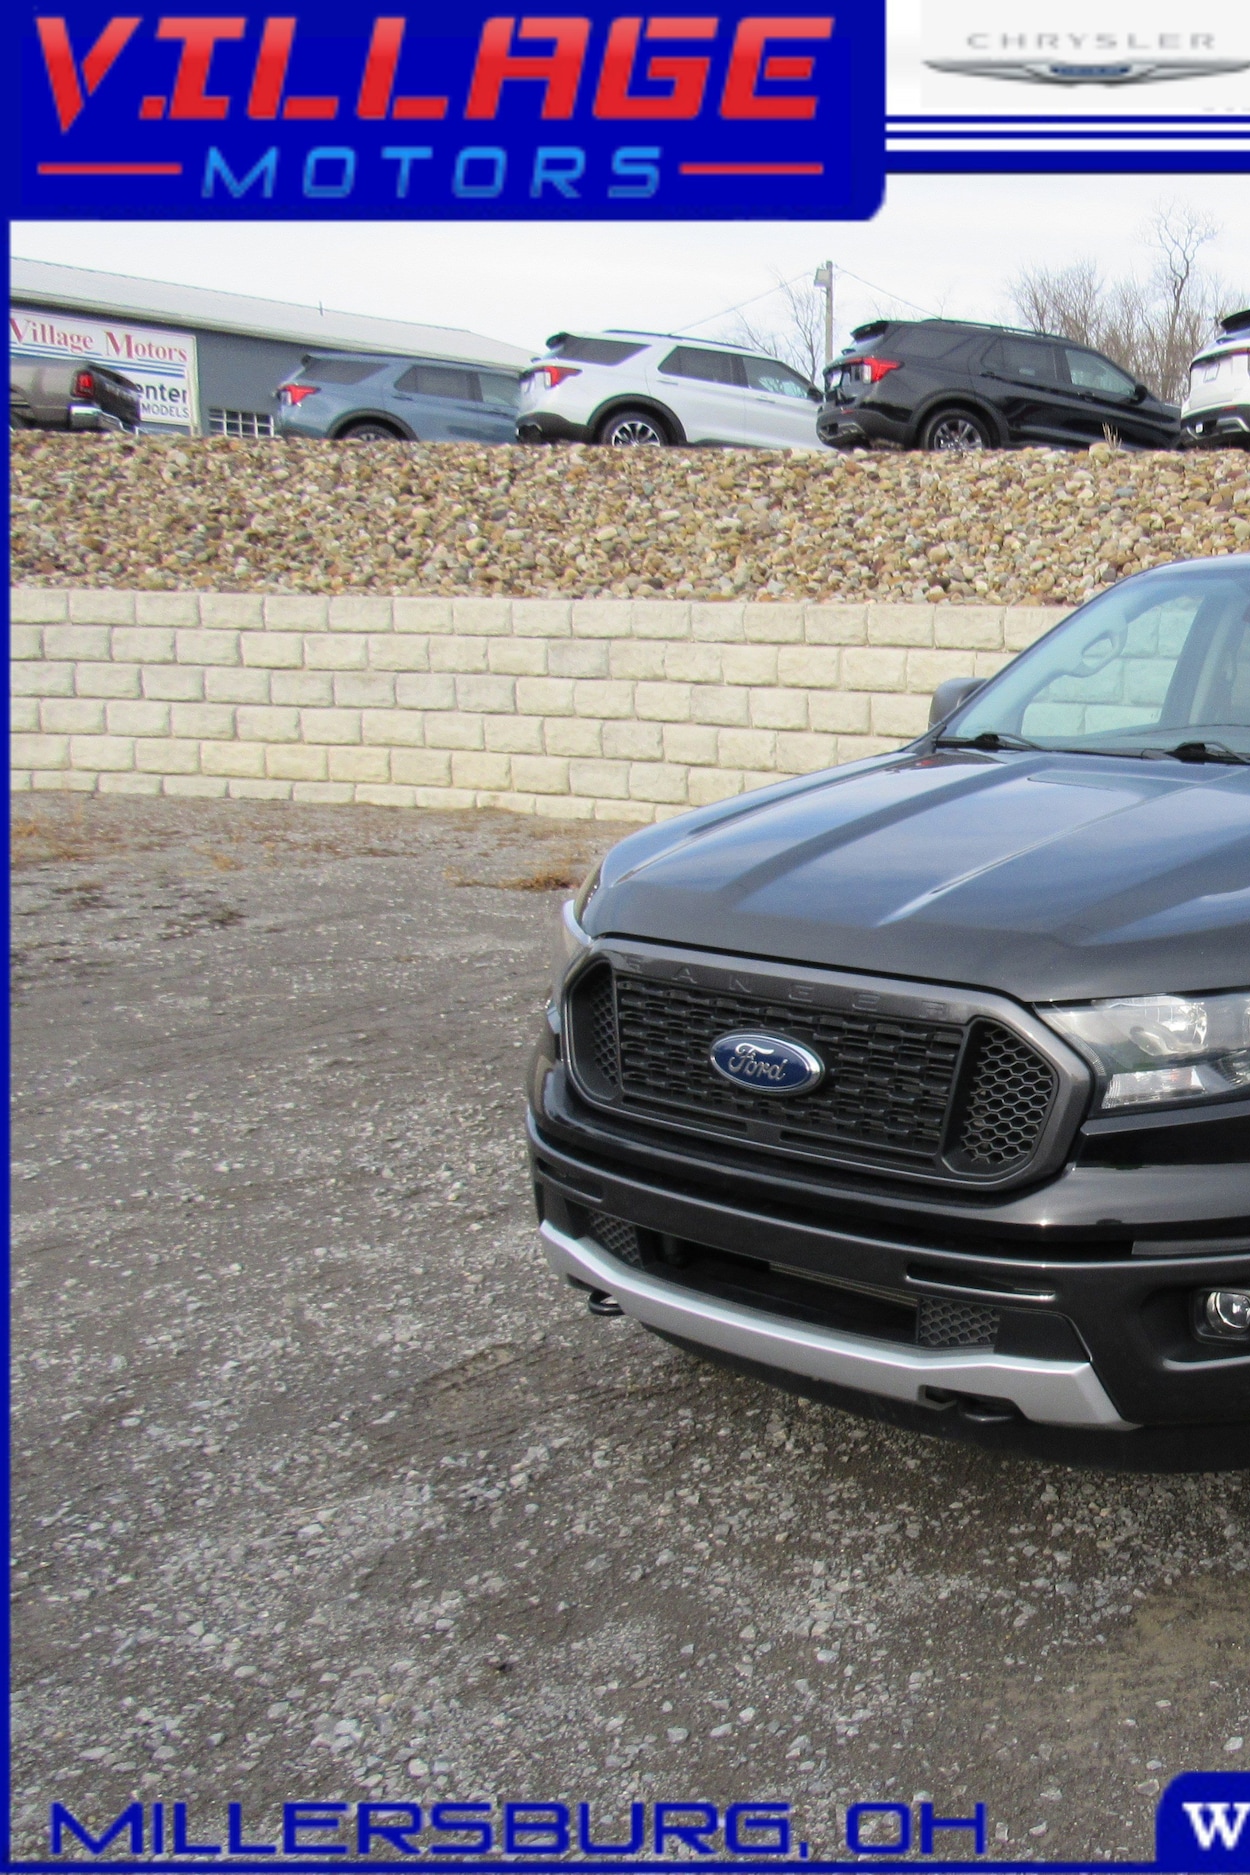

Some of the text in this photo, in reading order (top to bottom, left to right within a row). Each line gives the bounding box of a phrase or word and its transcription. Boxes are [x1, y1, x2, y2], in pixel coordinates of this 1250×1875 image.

[10, 317, 188, 362] Village Motors
[141, 403, 190, 419] MODELS
[727, 1042, 789, 1081] Ford
